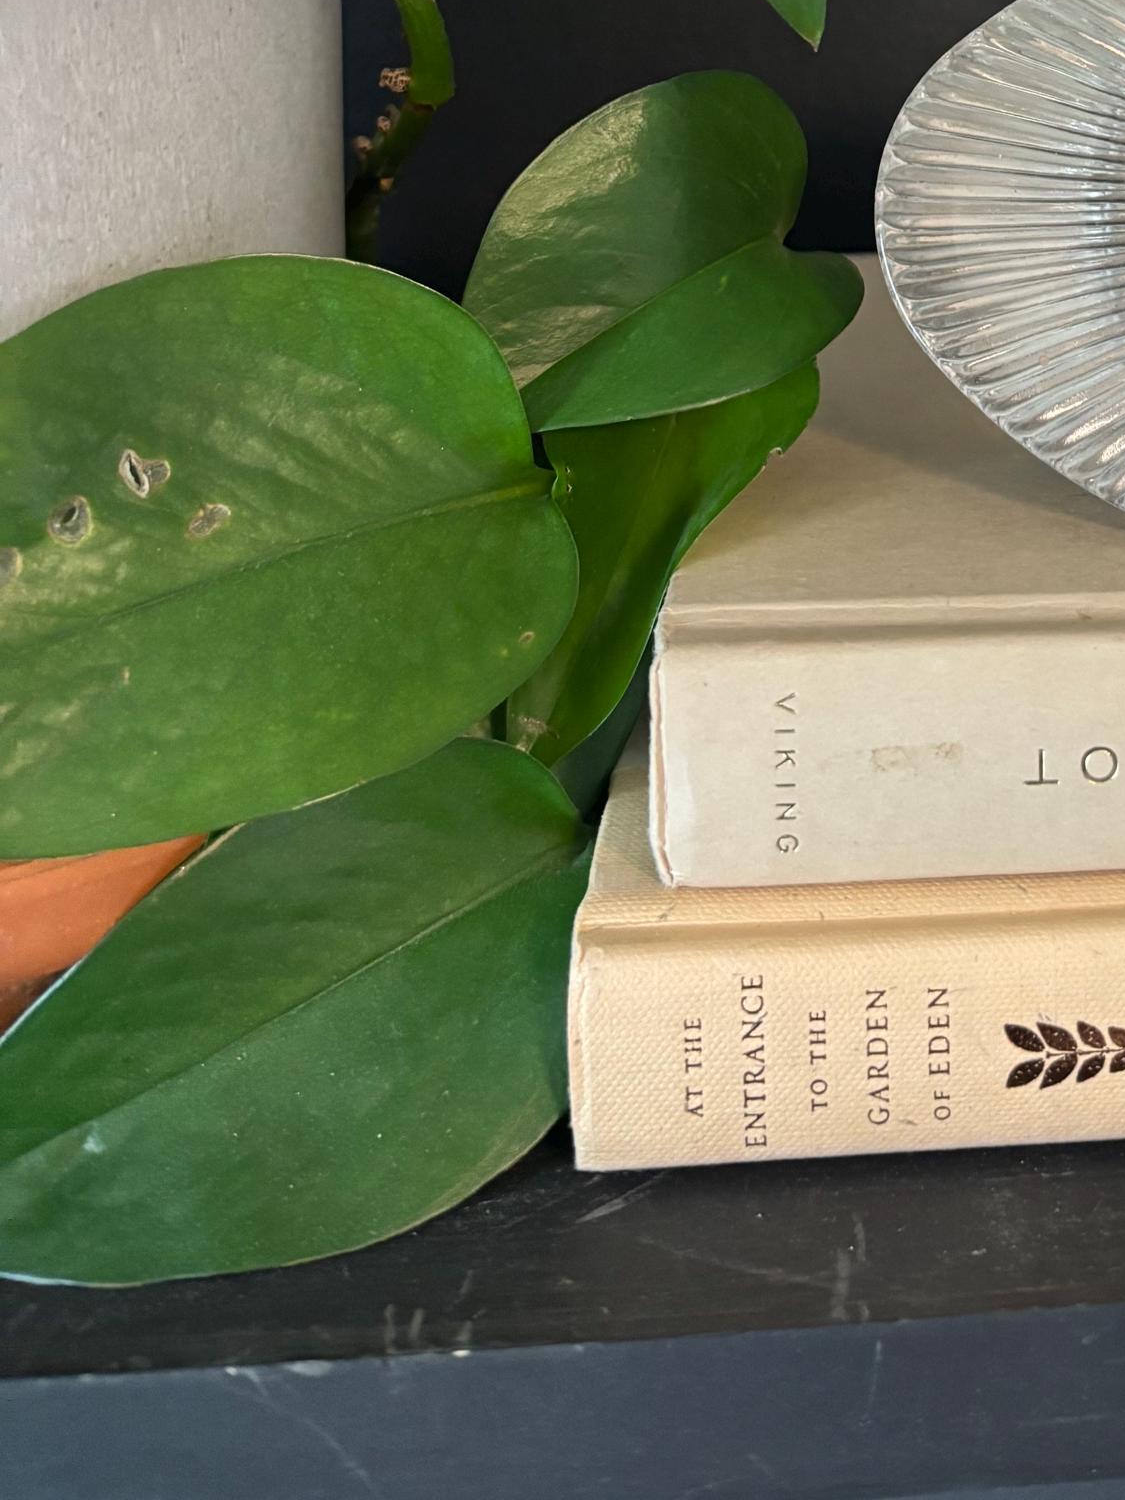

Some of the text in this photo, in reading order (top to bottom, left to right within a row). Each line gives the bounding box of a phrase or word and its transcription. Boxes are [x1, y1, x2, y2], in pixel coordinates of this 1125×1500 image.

[773, 691, 799, 855] VIKING
[684, 1017, 704, 1118] AT THE
[741, 974, 767, 1148] ENTRANCE
[809, 1009, 828, 1112] TO THE
[866, 989, 890, 1125] GARDEN
[927, 987, 951, 1121] OF EDEN
